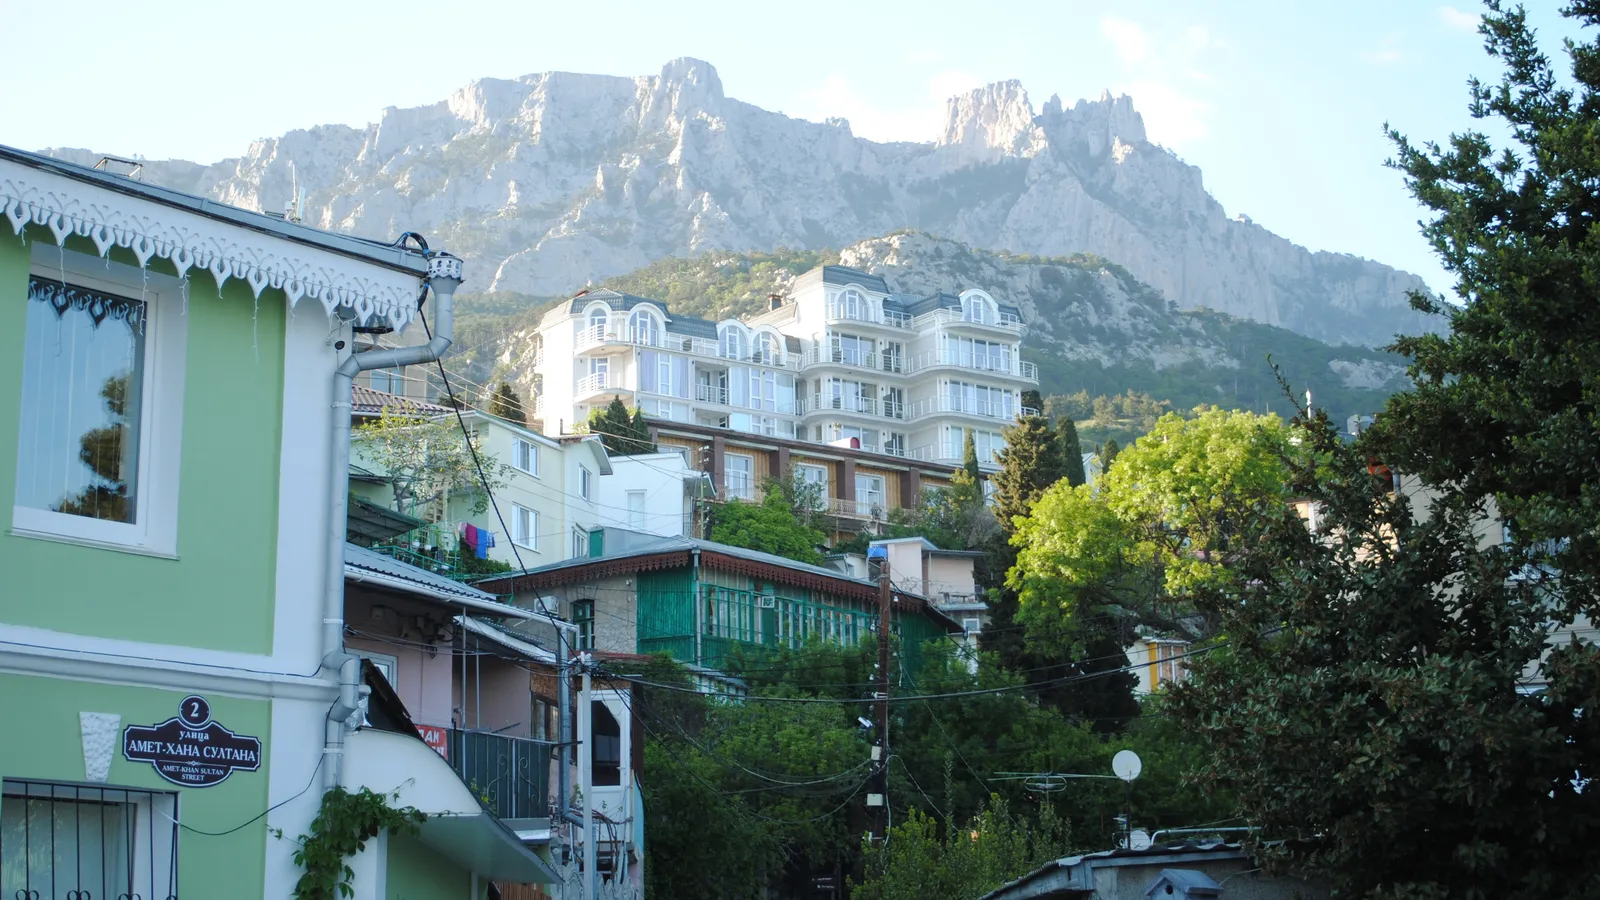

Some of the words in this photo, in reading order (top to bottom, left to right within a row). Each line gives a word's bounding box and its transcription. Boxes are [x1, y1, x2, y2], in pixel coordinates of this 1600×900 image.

[190, 702, 199, 717] 2
[179, 730, 209, 742] улица
[128, 740, 200, 756] АМЕТ-ХАНА
[203, 746, 256, 762] СУЛТАНА
[162, 765, 200, 773] AMET-KHAN
[182, 773, 204, 781] STREET
